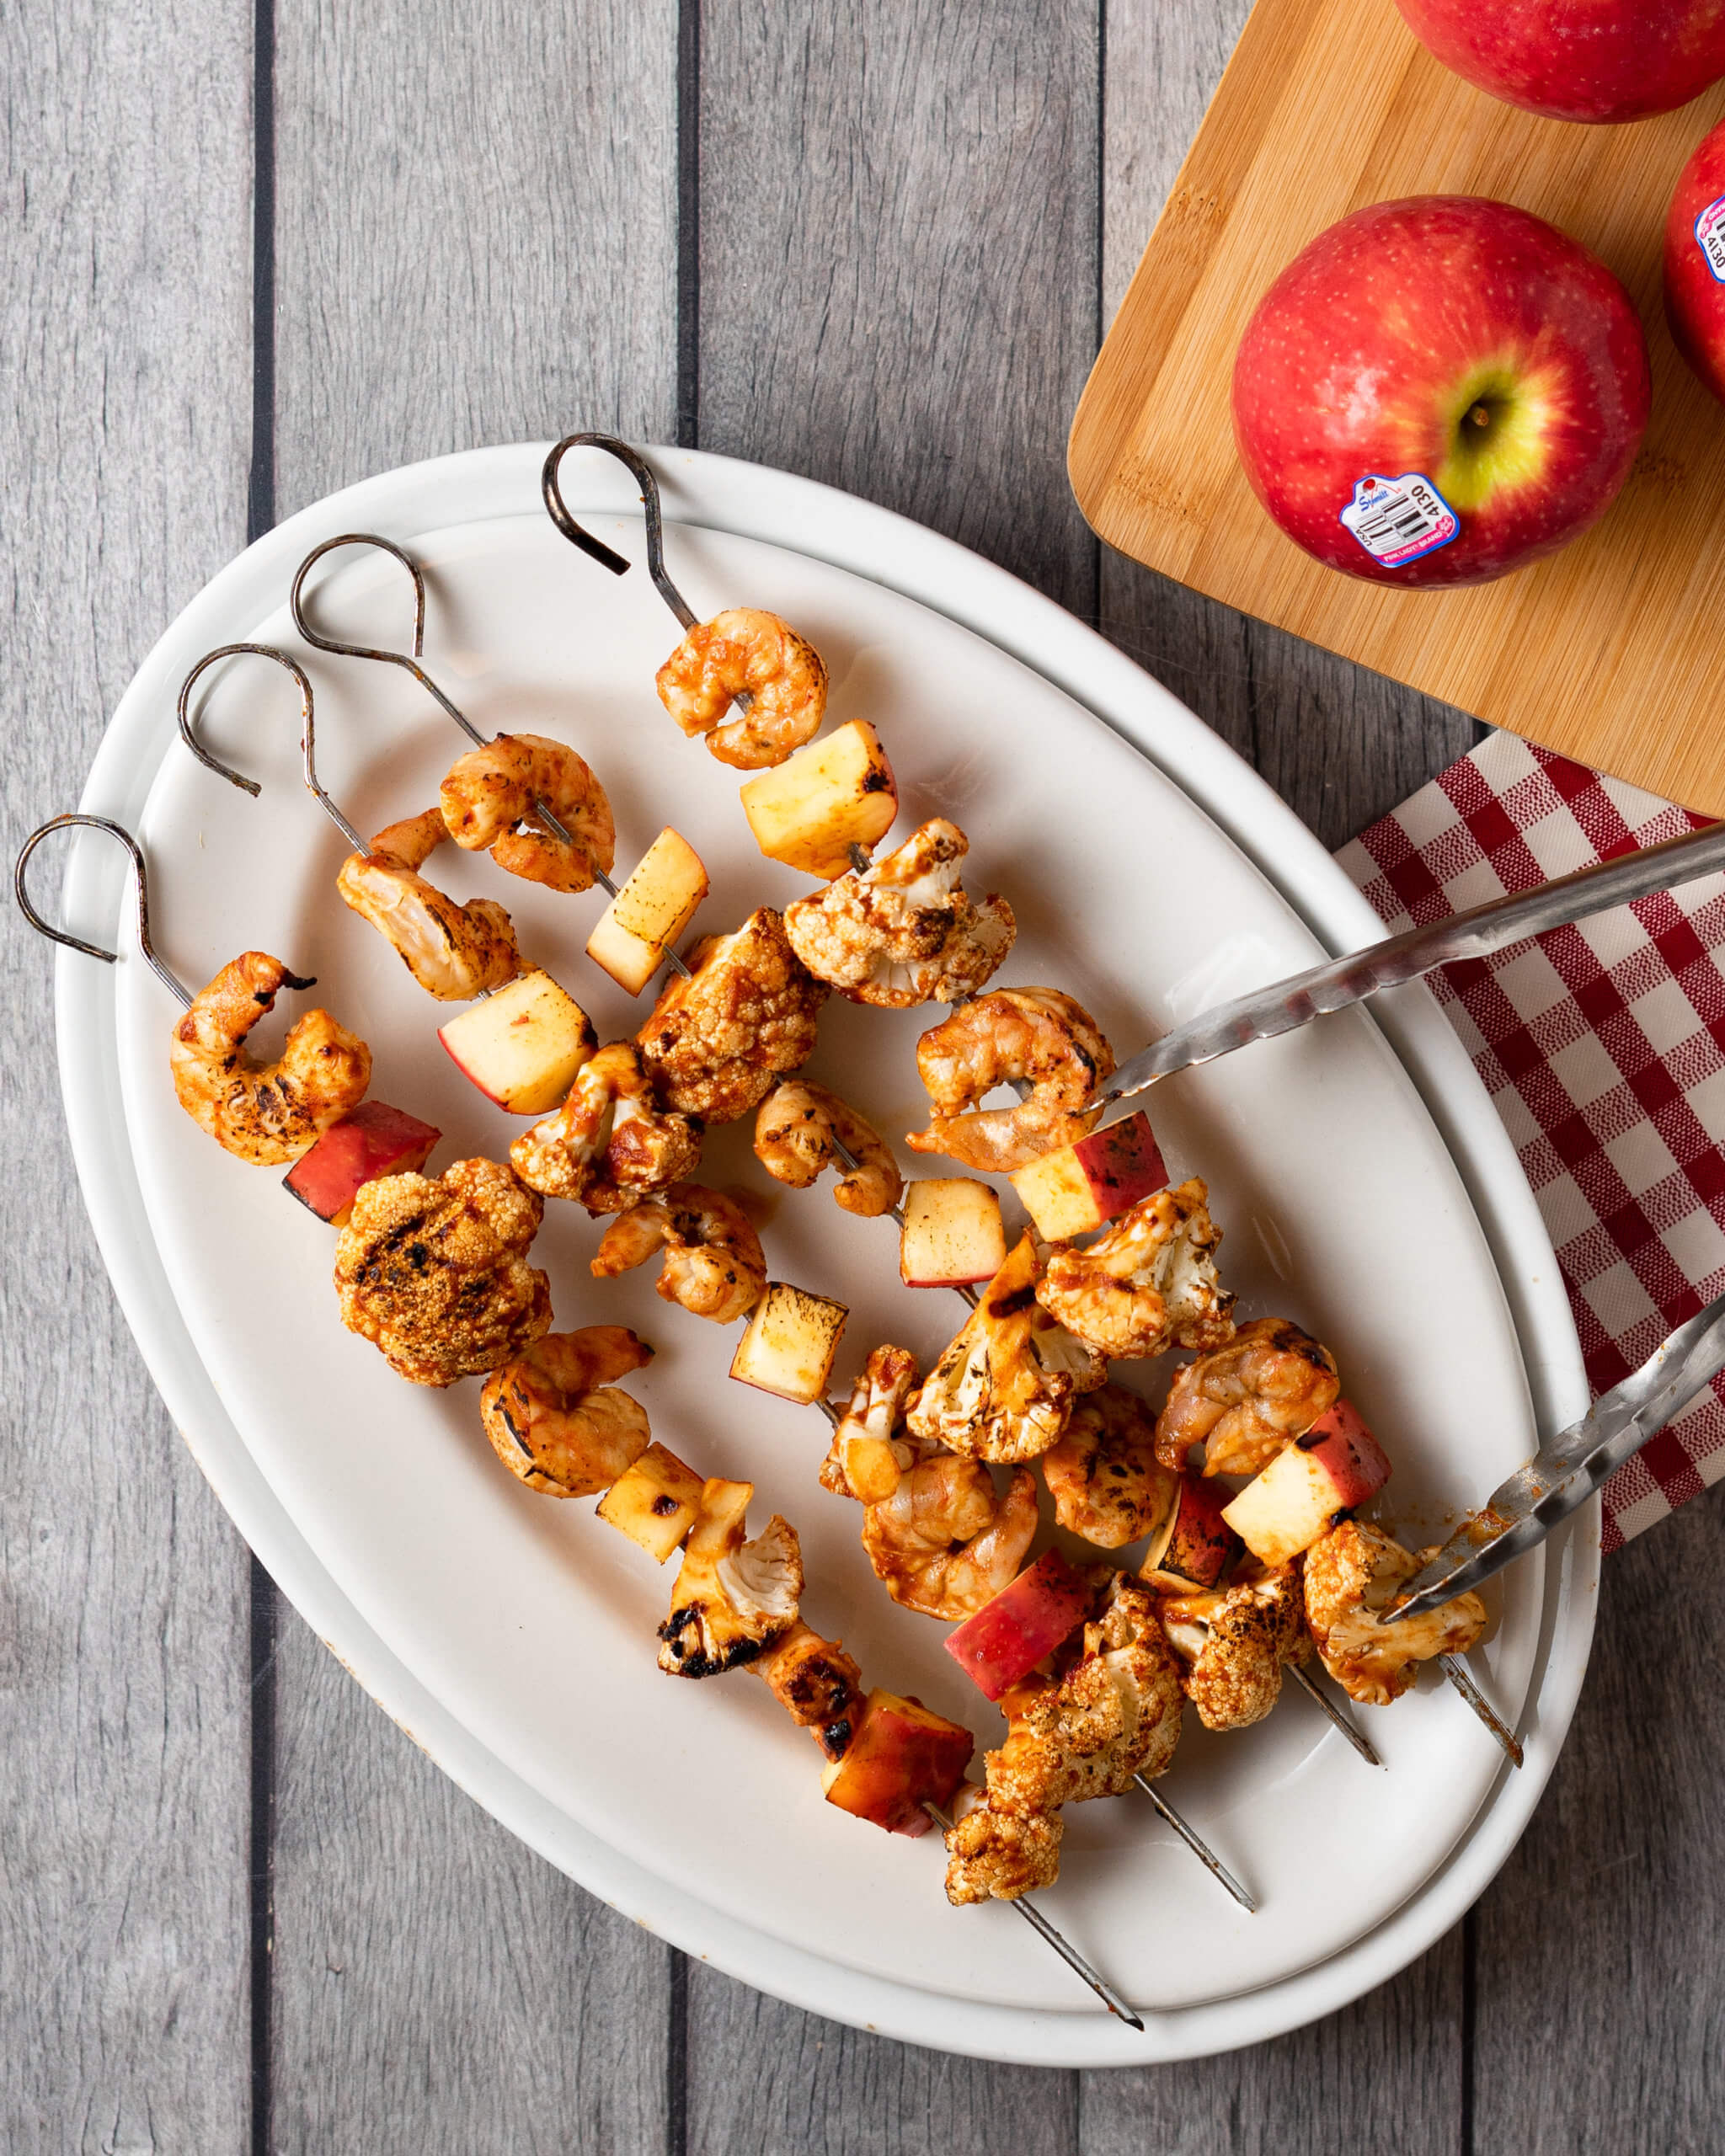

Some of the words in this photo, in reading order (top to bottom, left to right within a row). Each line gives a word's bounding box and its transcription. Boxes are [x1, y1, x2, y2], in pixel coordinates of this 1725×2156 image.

[1707, 237, 1725, 268] 4130
[1411, 485, 1439, 516] 4130
[1355, 529, 1372, 547] USA
[1418, 531, 1443, 547] BRAND
